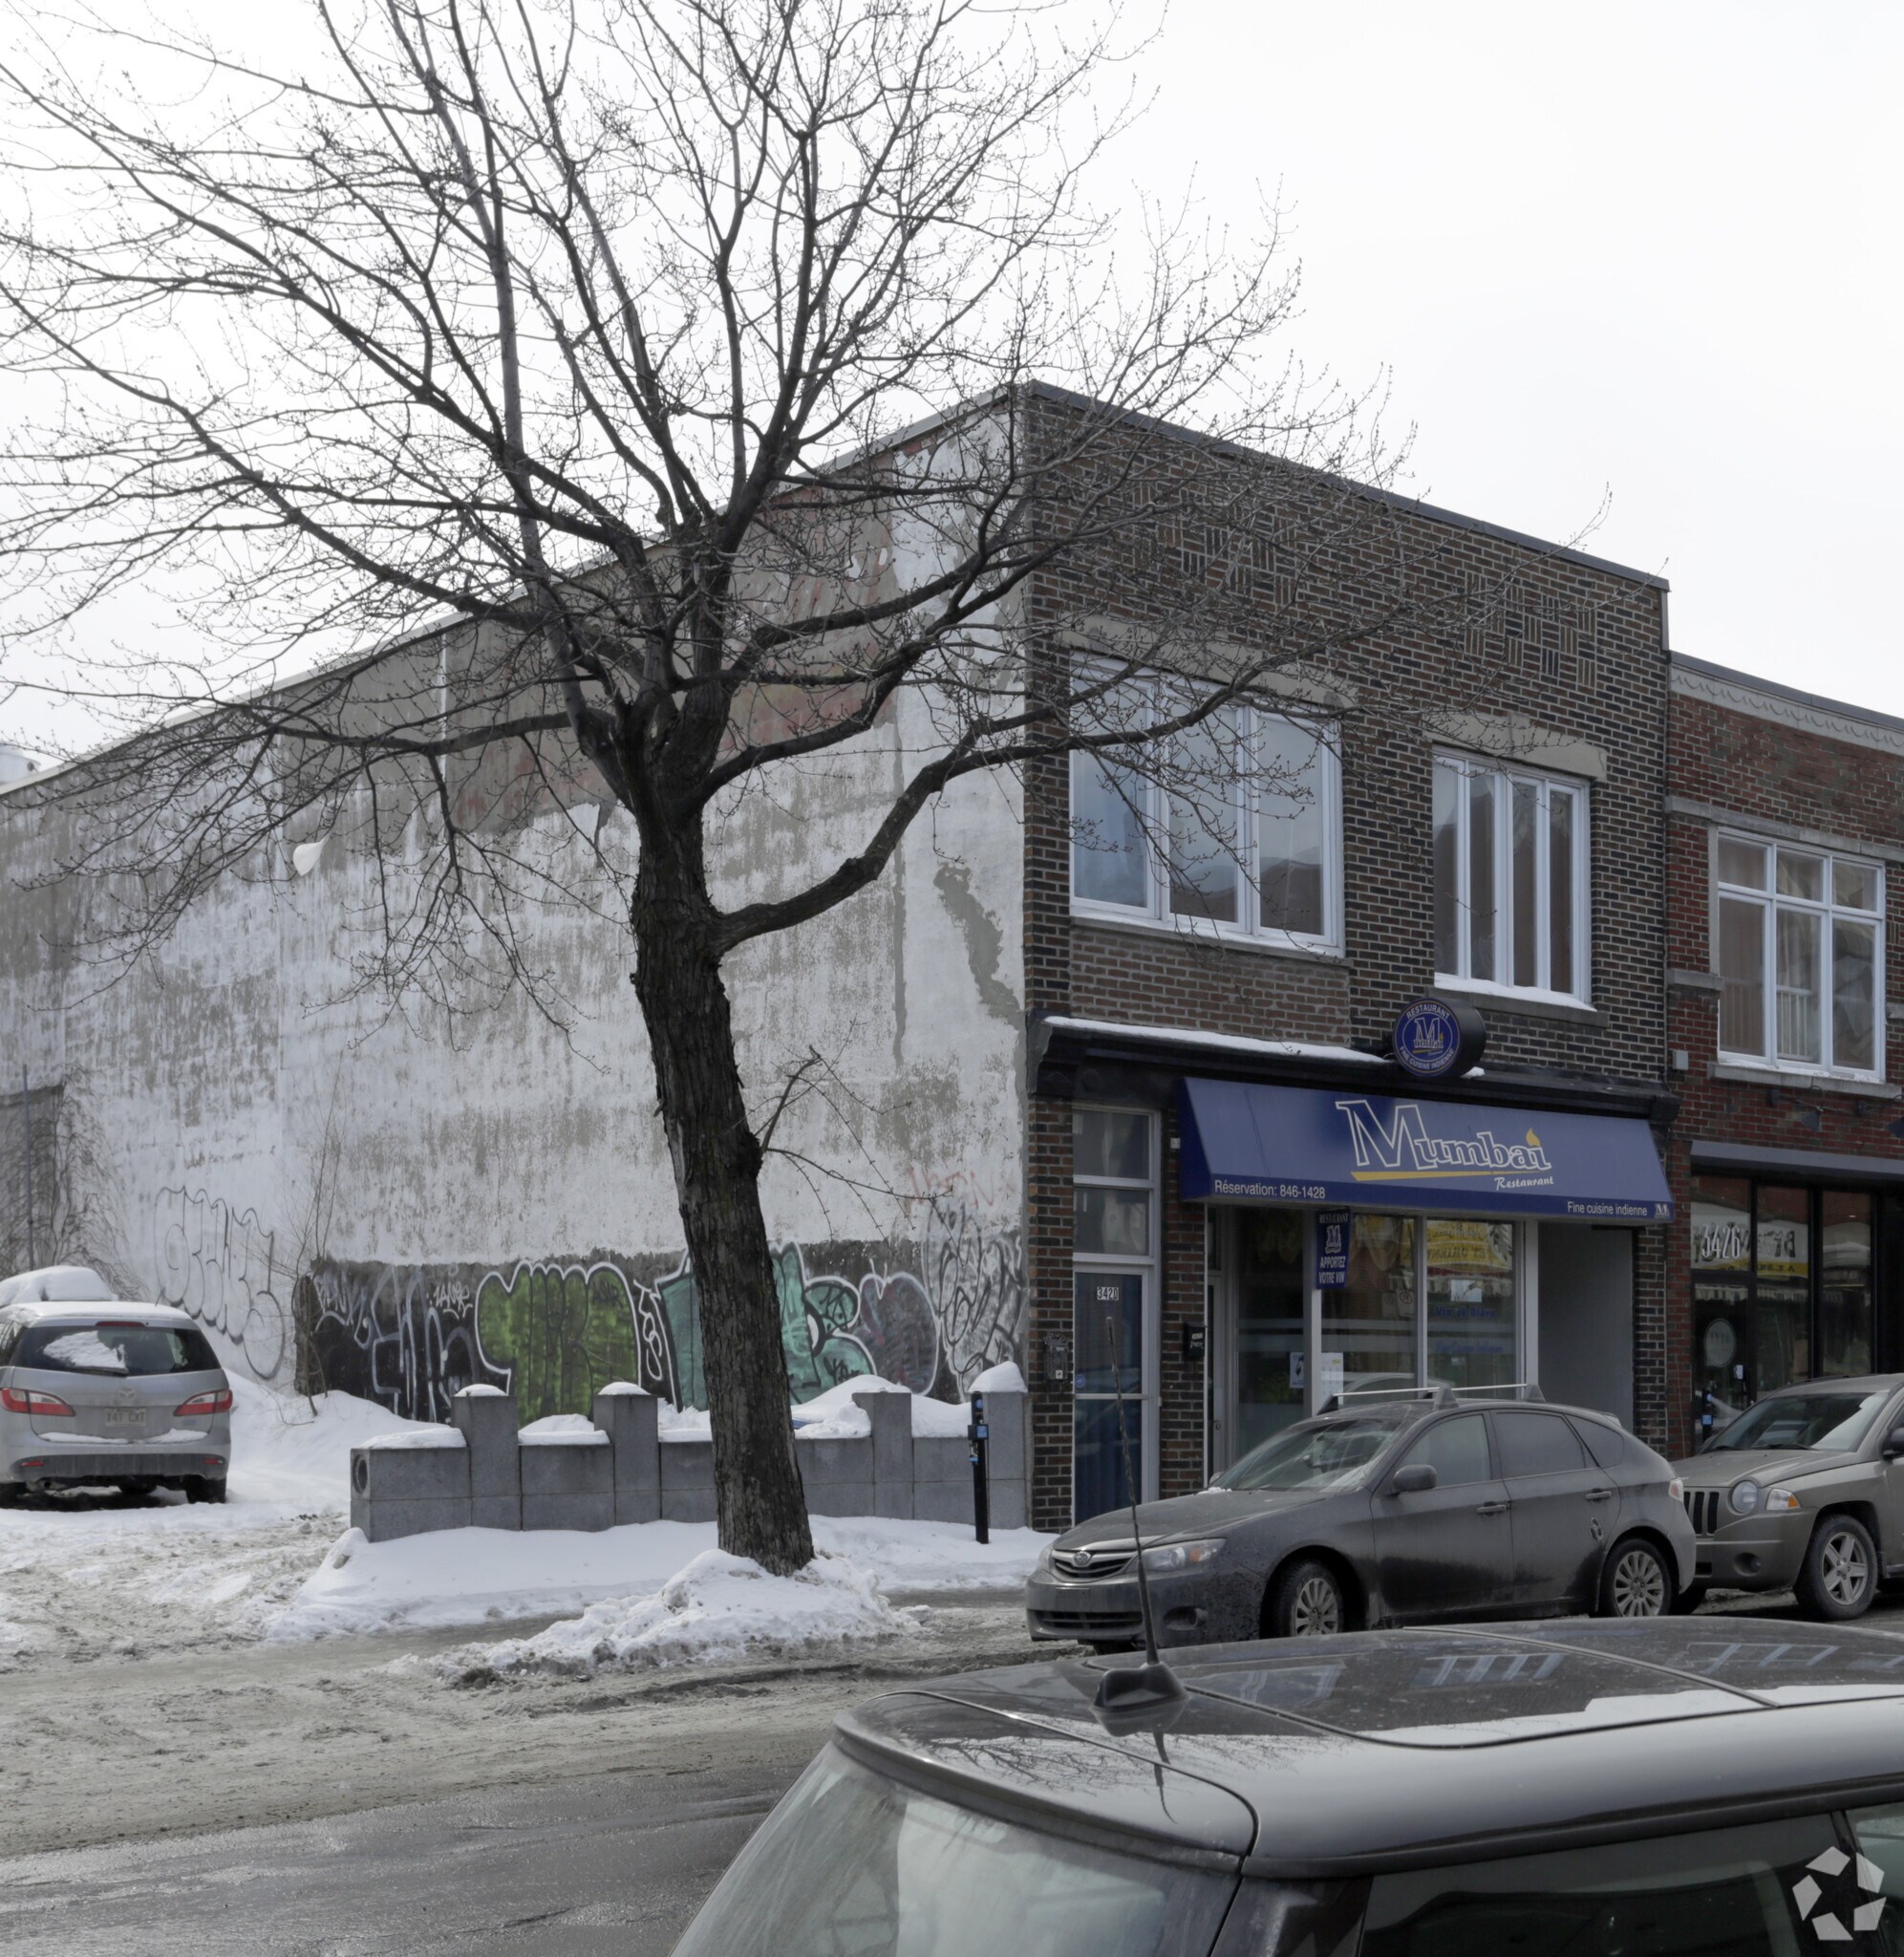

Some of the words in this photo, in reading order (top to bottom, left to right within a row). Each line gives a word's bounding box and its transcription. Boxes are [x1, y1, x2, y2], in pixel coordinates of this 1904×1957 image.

[1406, 1003, 1450, 1020] RESTAURANT
[1409, 1058, 1431, 1070] CUISINE
[1431, 1047, 1455, 1069] INDIENNE
[1335, 1100, 1551, 1171] Mumbai
[1214, 1179, 1277, 1196] Réservation:
[1279, 1184, 1326, 1199] 846-1428
[1494, 1176, 1554, 1191] Restaurant
[1567, 1201, 1585, 1214] Fine
[1586, 1202, 1614, 1215] cuisine
[1615, 1203, 1648, 1216] indienne
[1701, 1223, 1741, 1259] 3426
[1319, 1256, 1347, 1269] APPORTEZ
[1318, 1271, 1336, 1284] VOTRE
[1336, 1271, 1346, 1284] VIN
[1097, 1286, 1119, 1300] 3420
